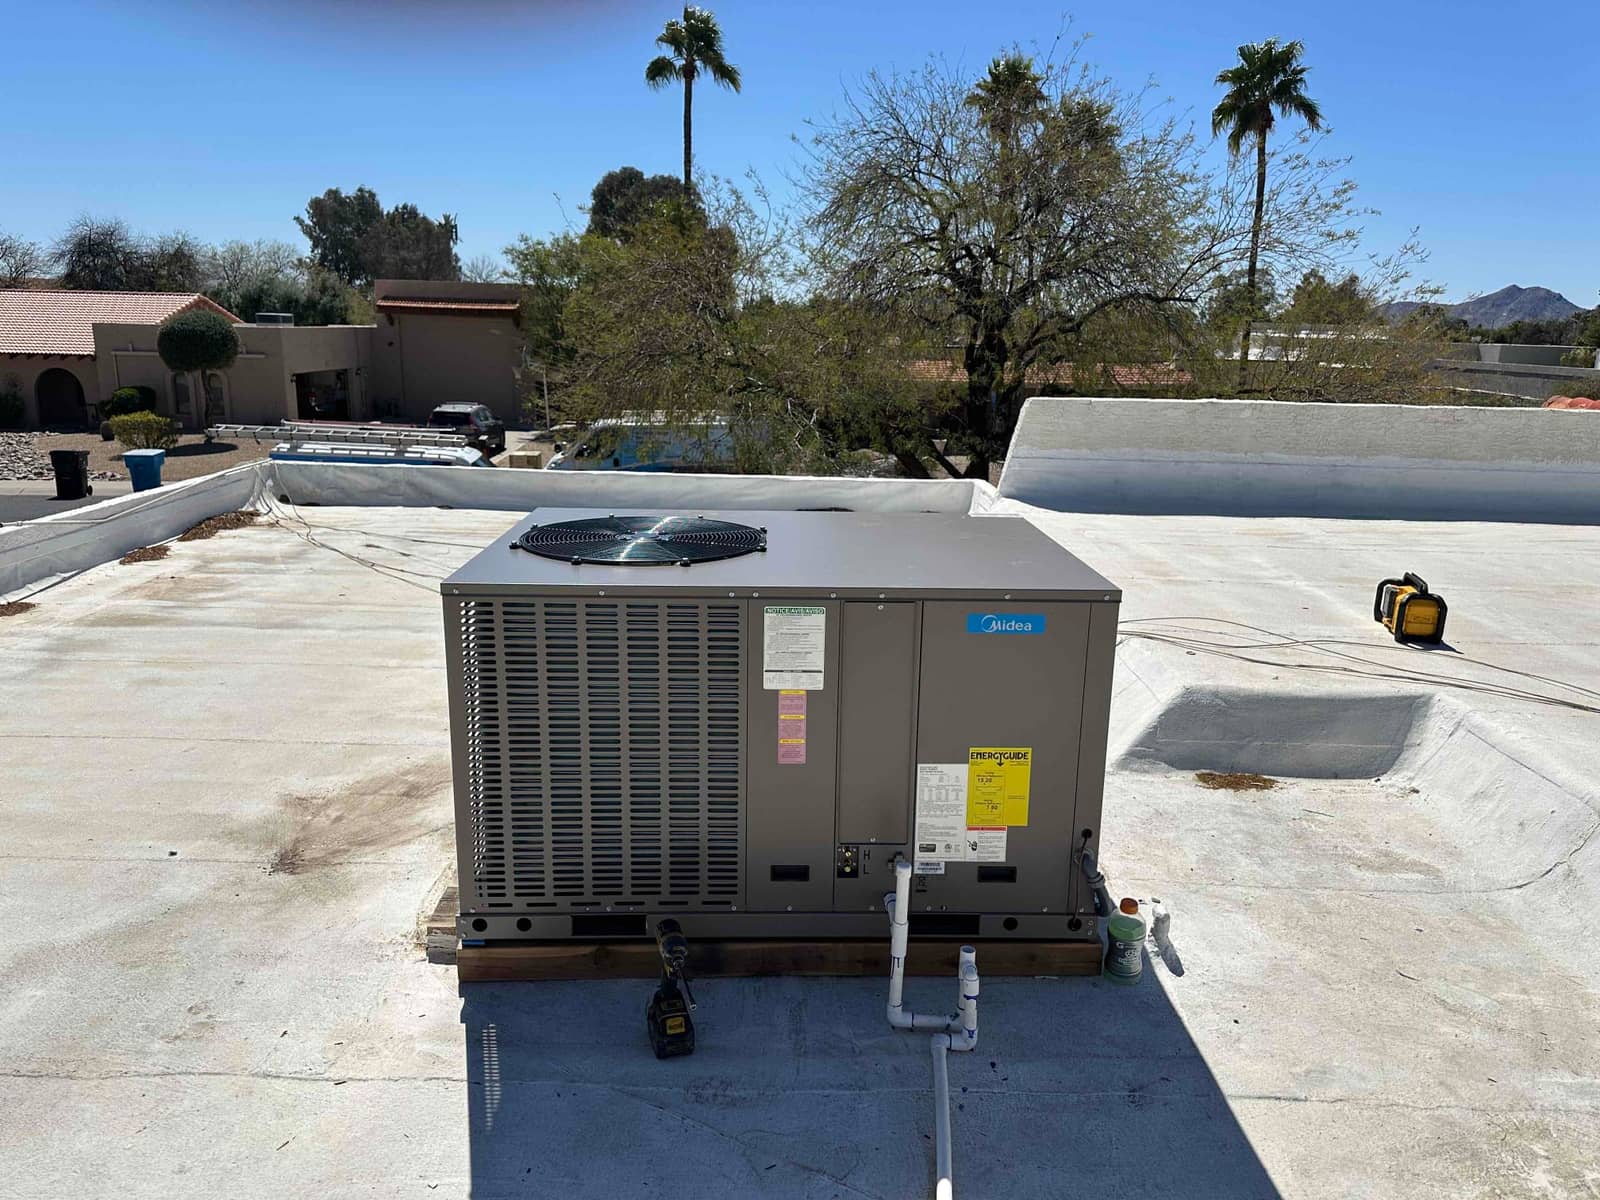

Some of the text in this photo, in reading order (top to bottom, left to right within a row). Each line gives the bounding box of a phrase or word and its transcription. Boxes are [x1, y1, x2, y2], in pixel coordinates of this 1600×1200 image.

[982, 615, 1032, 632] Midea
[863, 849, 870, 861] H
[863, 863, 872, 875] L
